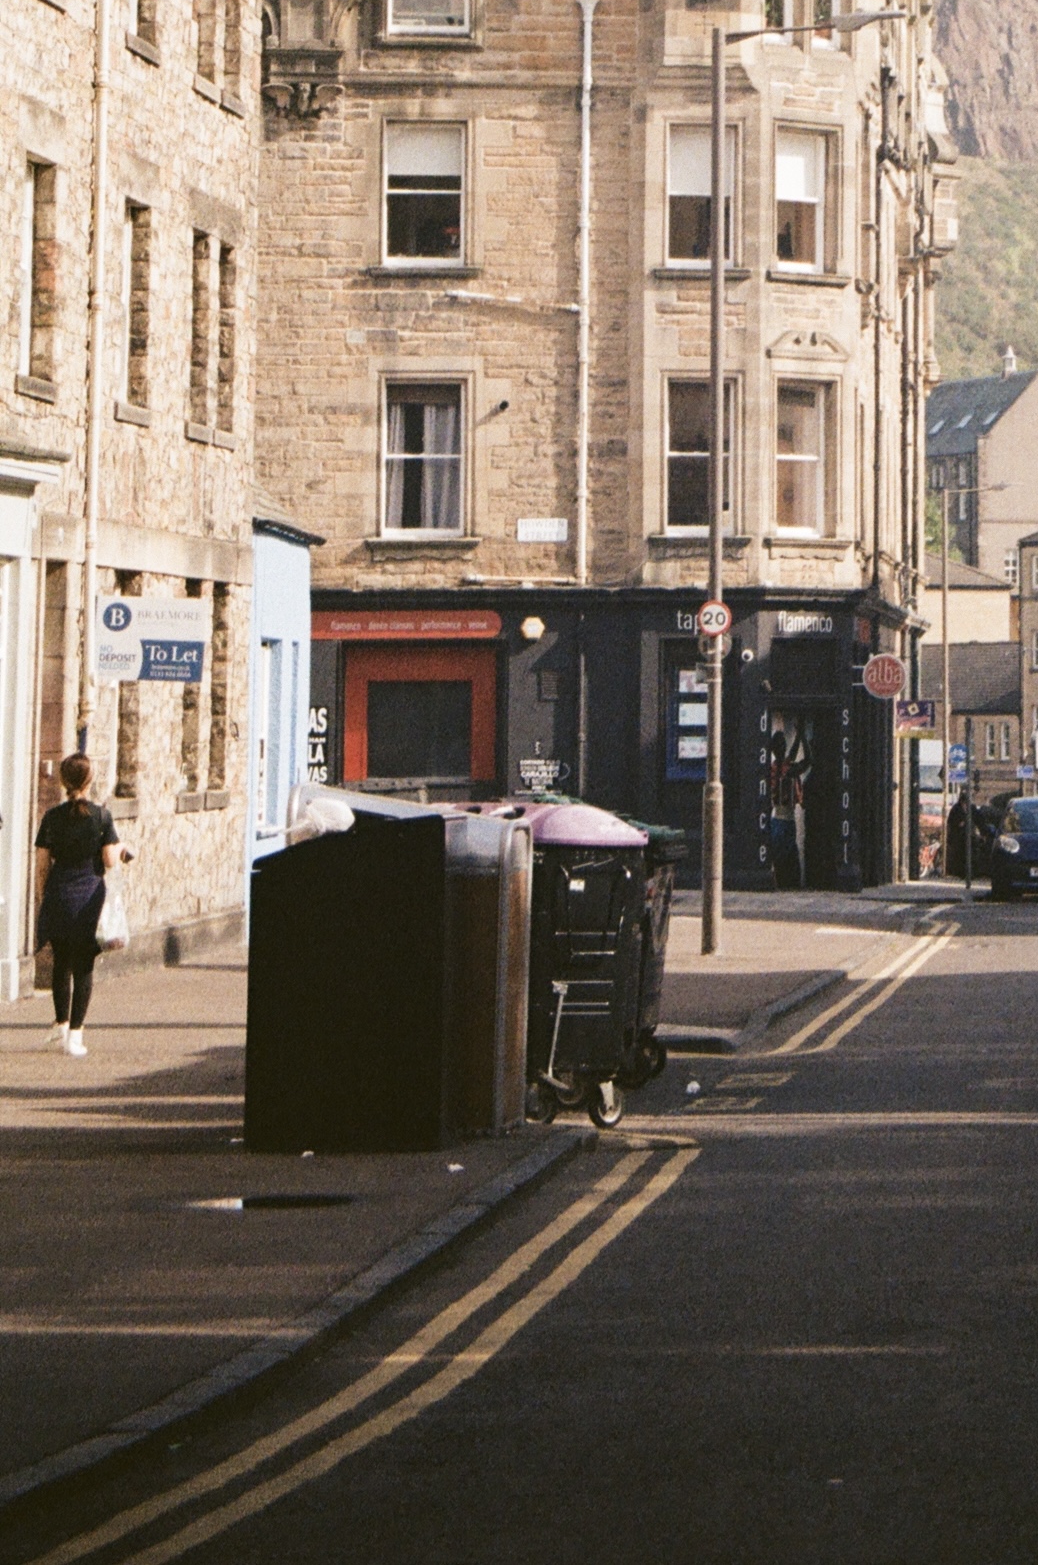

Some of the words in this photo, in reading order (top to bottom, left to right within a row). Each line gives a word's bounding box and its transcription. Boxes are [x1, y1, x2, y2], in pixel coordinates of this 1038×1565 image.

[110, 608, 125, 627] B
[137, 609, 201, 621] BRAEMORE
[676, 609, 701, 635] tap
[702, 611, 726, 626] 20
[777, 610, 833, 633] flamenco
[99, 653, 137, 663] DEPOSIT
[146, 645, 167, 661] To
[172, 646, 198, 662] Let
[867, 659, 902, 683] alba
[308, 707, 327, 733] AS
[308, 744, 325, 764] LA
[759, 709, 768, 862] dance
[842, 708, 850, 865] school
